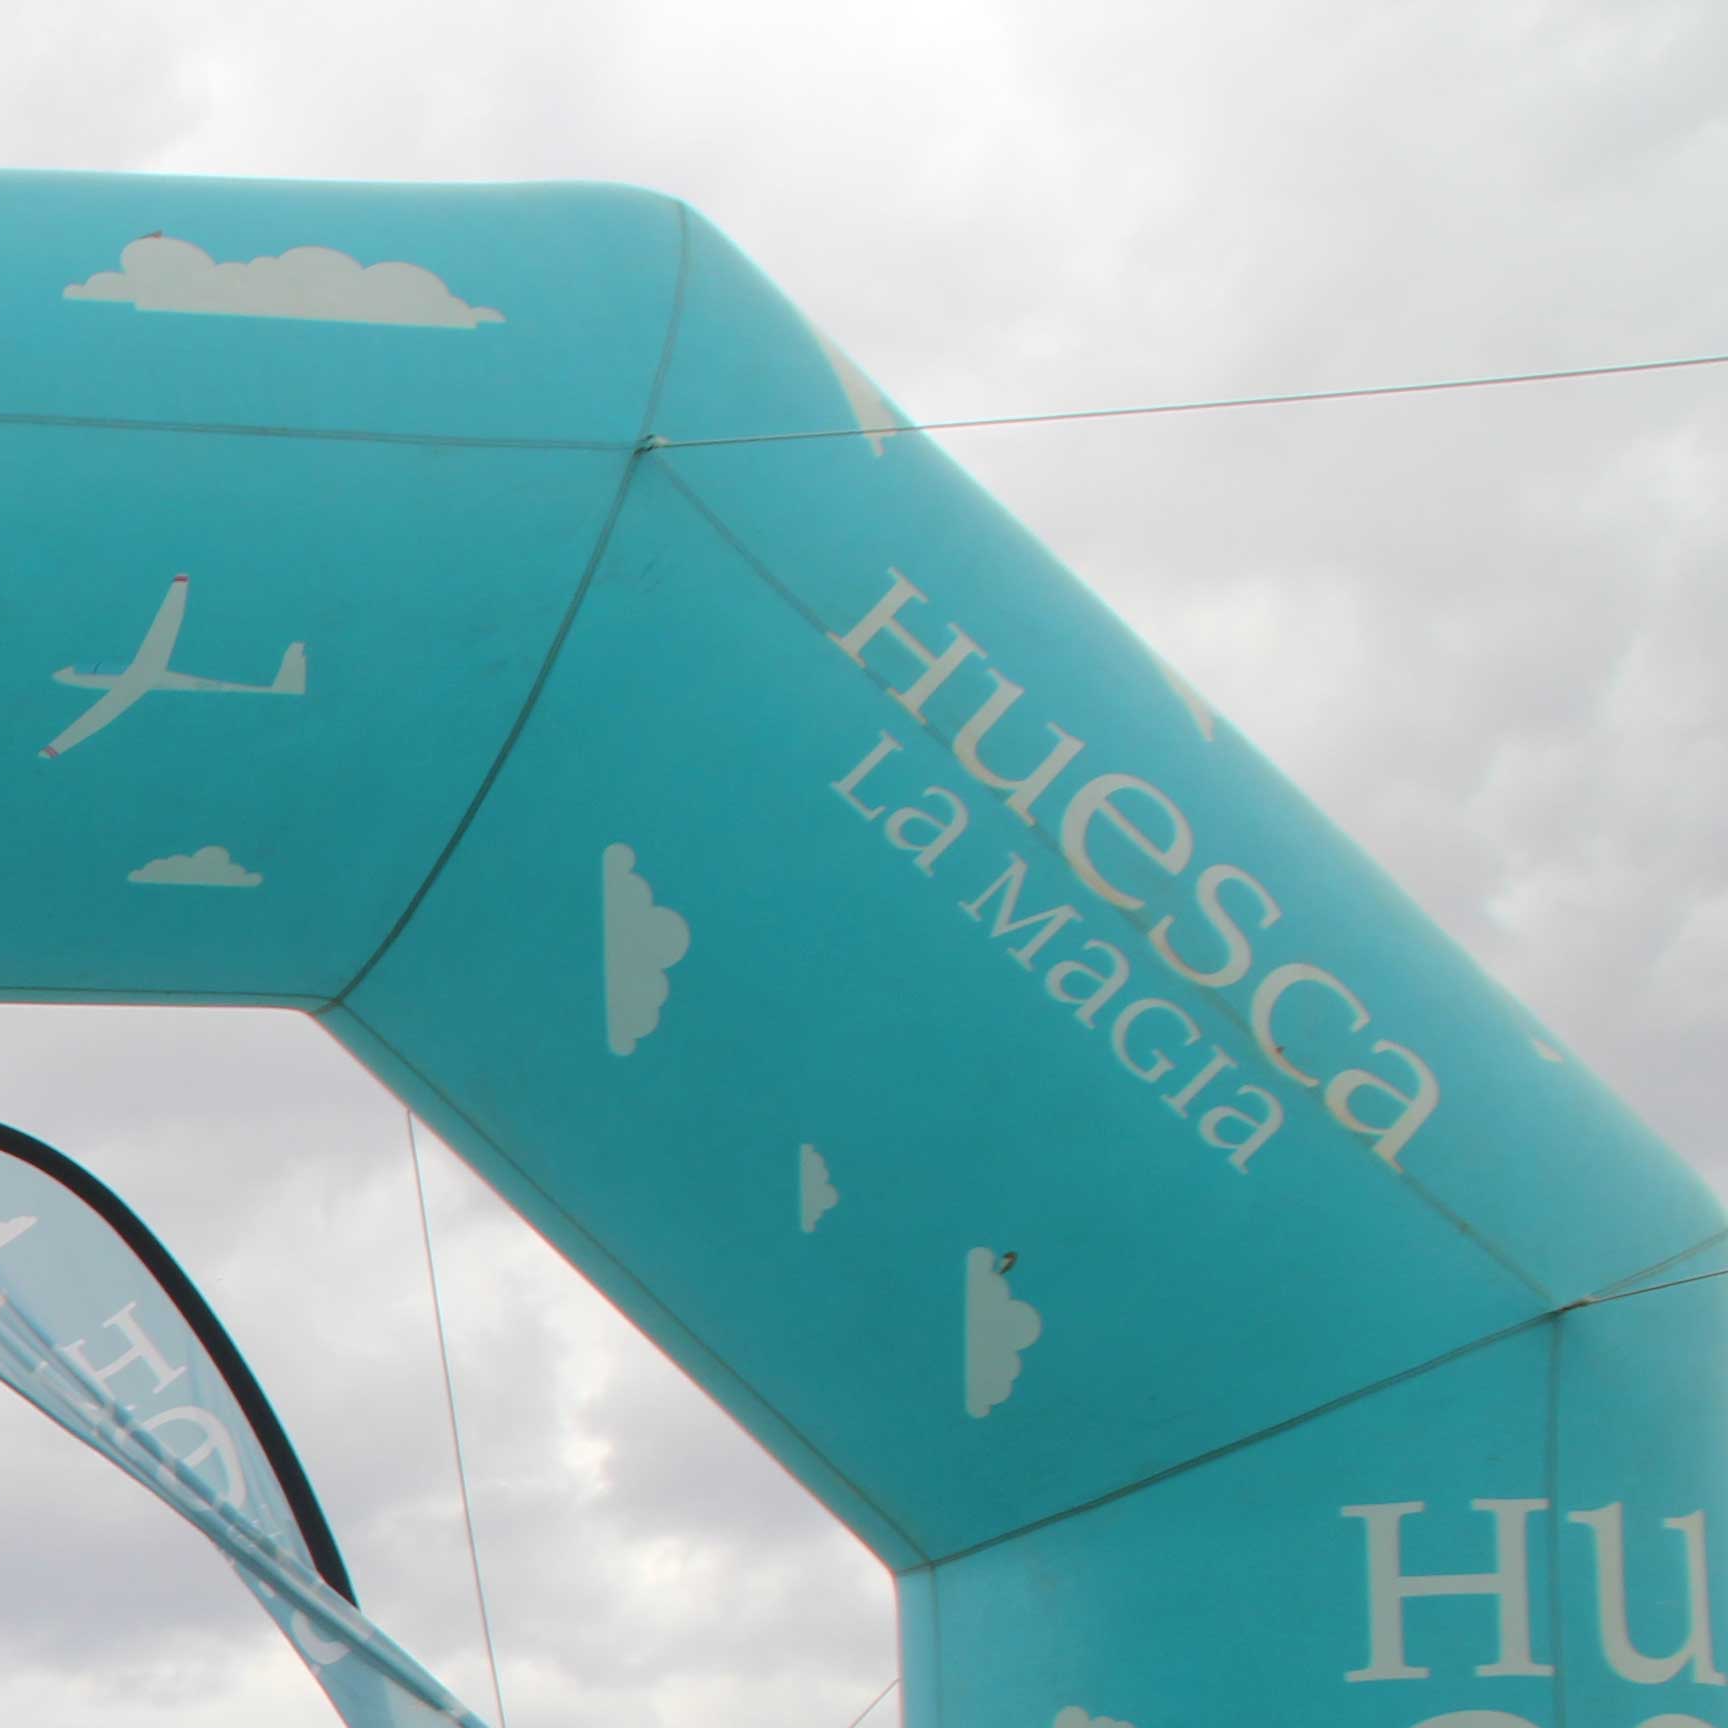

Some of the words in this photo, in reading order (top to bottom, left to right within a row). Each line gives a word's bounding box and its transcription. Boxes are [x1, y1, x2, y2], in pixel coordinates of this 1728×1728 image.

[827, 566, 1440, 1175] Huesca
[829, 729, 970, 878] La
[1340, 1496, 1728, 1686] Hu
